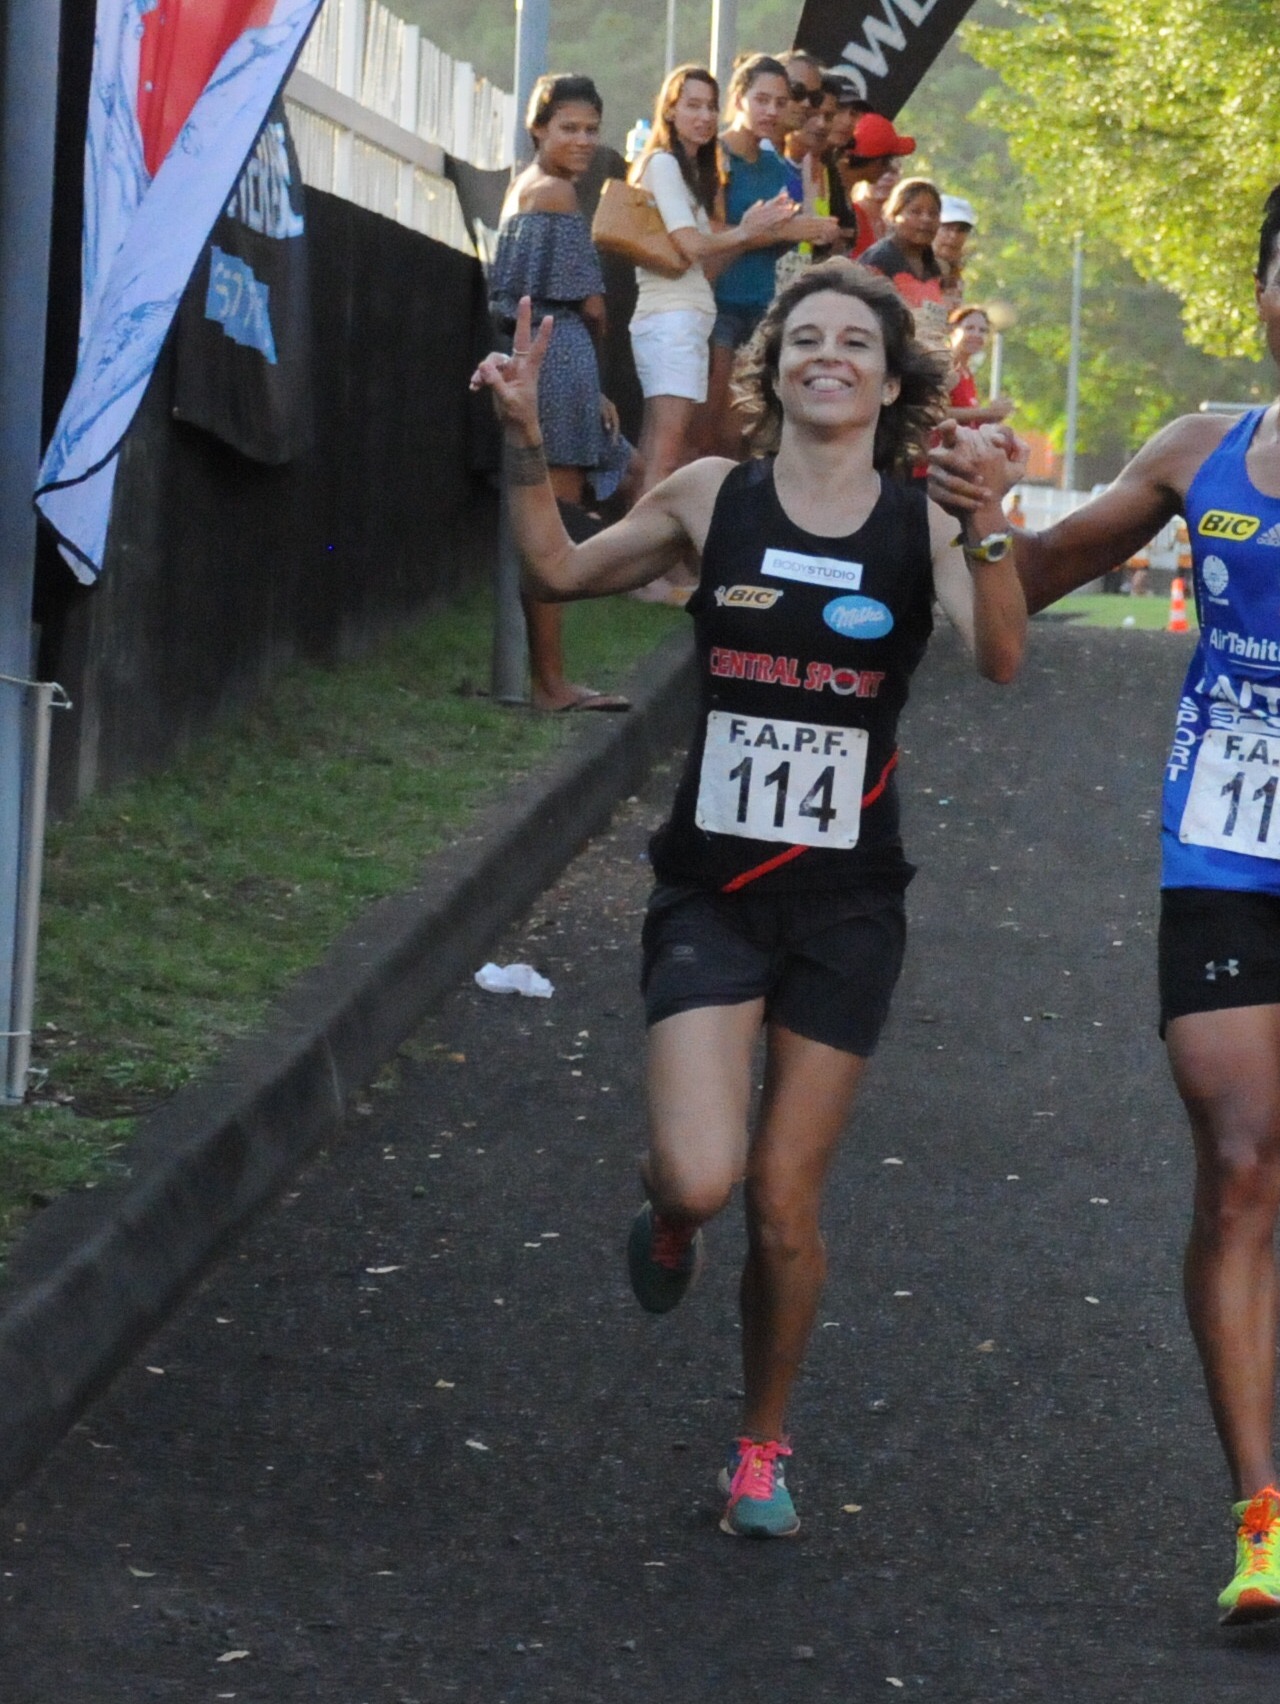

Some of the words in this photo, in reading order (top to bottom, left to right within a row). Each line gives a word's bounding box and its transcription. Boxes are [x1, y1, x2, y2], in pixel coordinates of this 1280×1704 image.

[711, 647, 801, 687] CENTRAL
[804, 661, 886, 698] SPORT
[728, 756, 837, 833] 114
